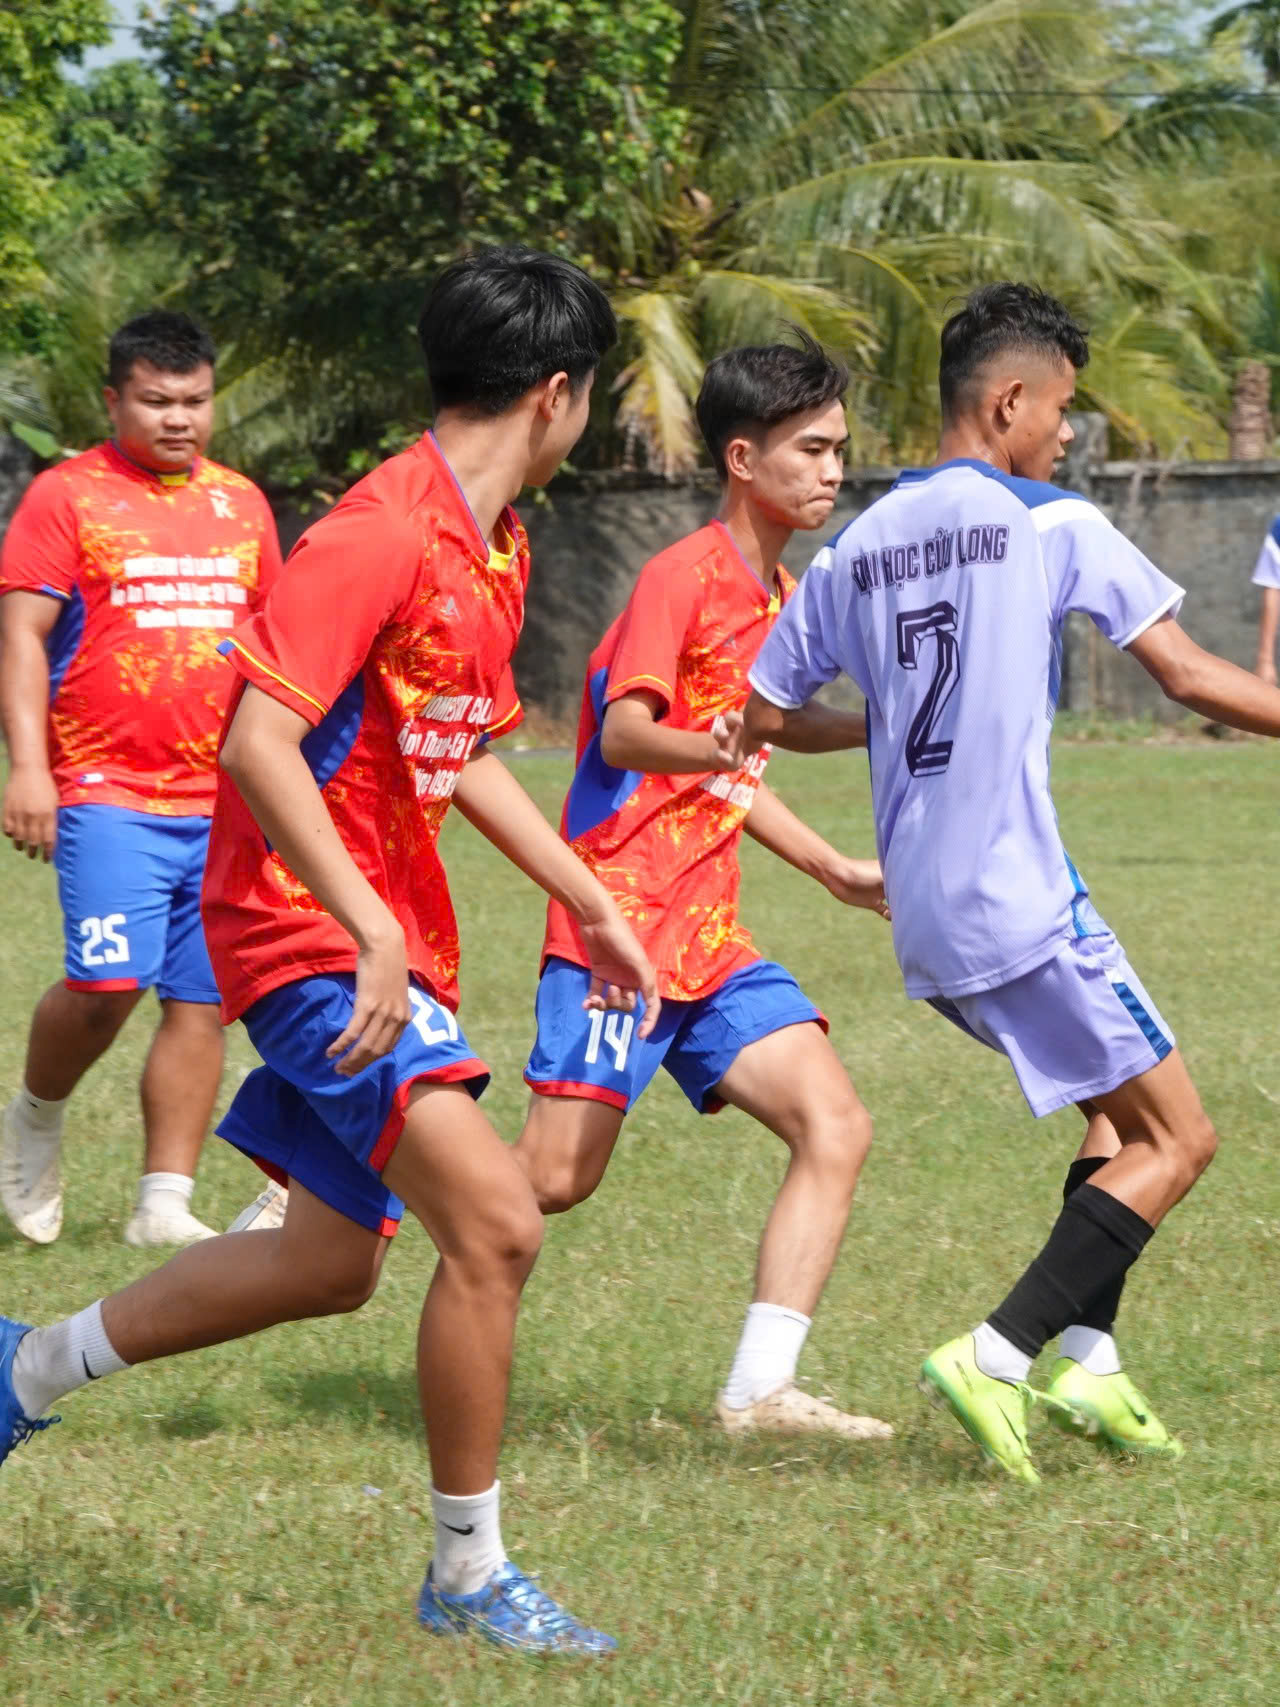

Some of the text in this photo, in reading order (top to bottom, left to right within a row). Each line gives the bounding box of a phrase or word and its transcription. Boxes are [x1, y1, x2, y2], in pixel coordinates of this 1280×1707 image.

[881, 543, 920, 591] HỌC
[957, 524, 1009, 568] LONG
[897, 601, 960, 778] 2
[80, 913, 130, 966] 25
[584, 1008, 634, 1072] 14
